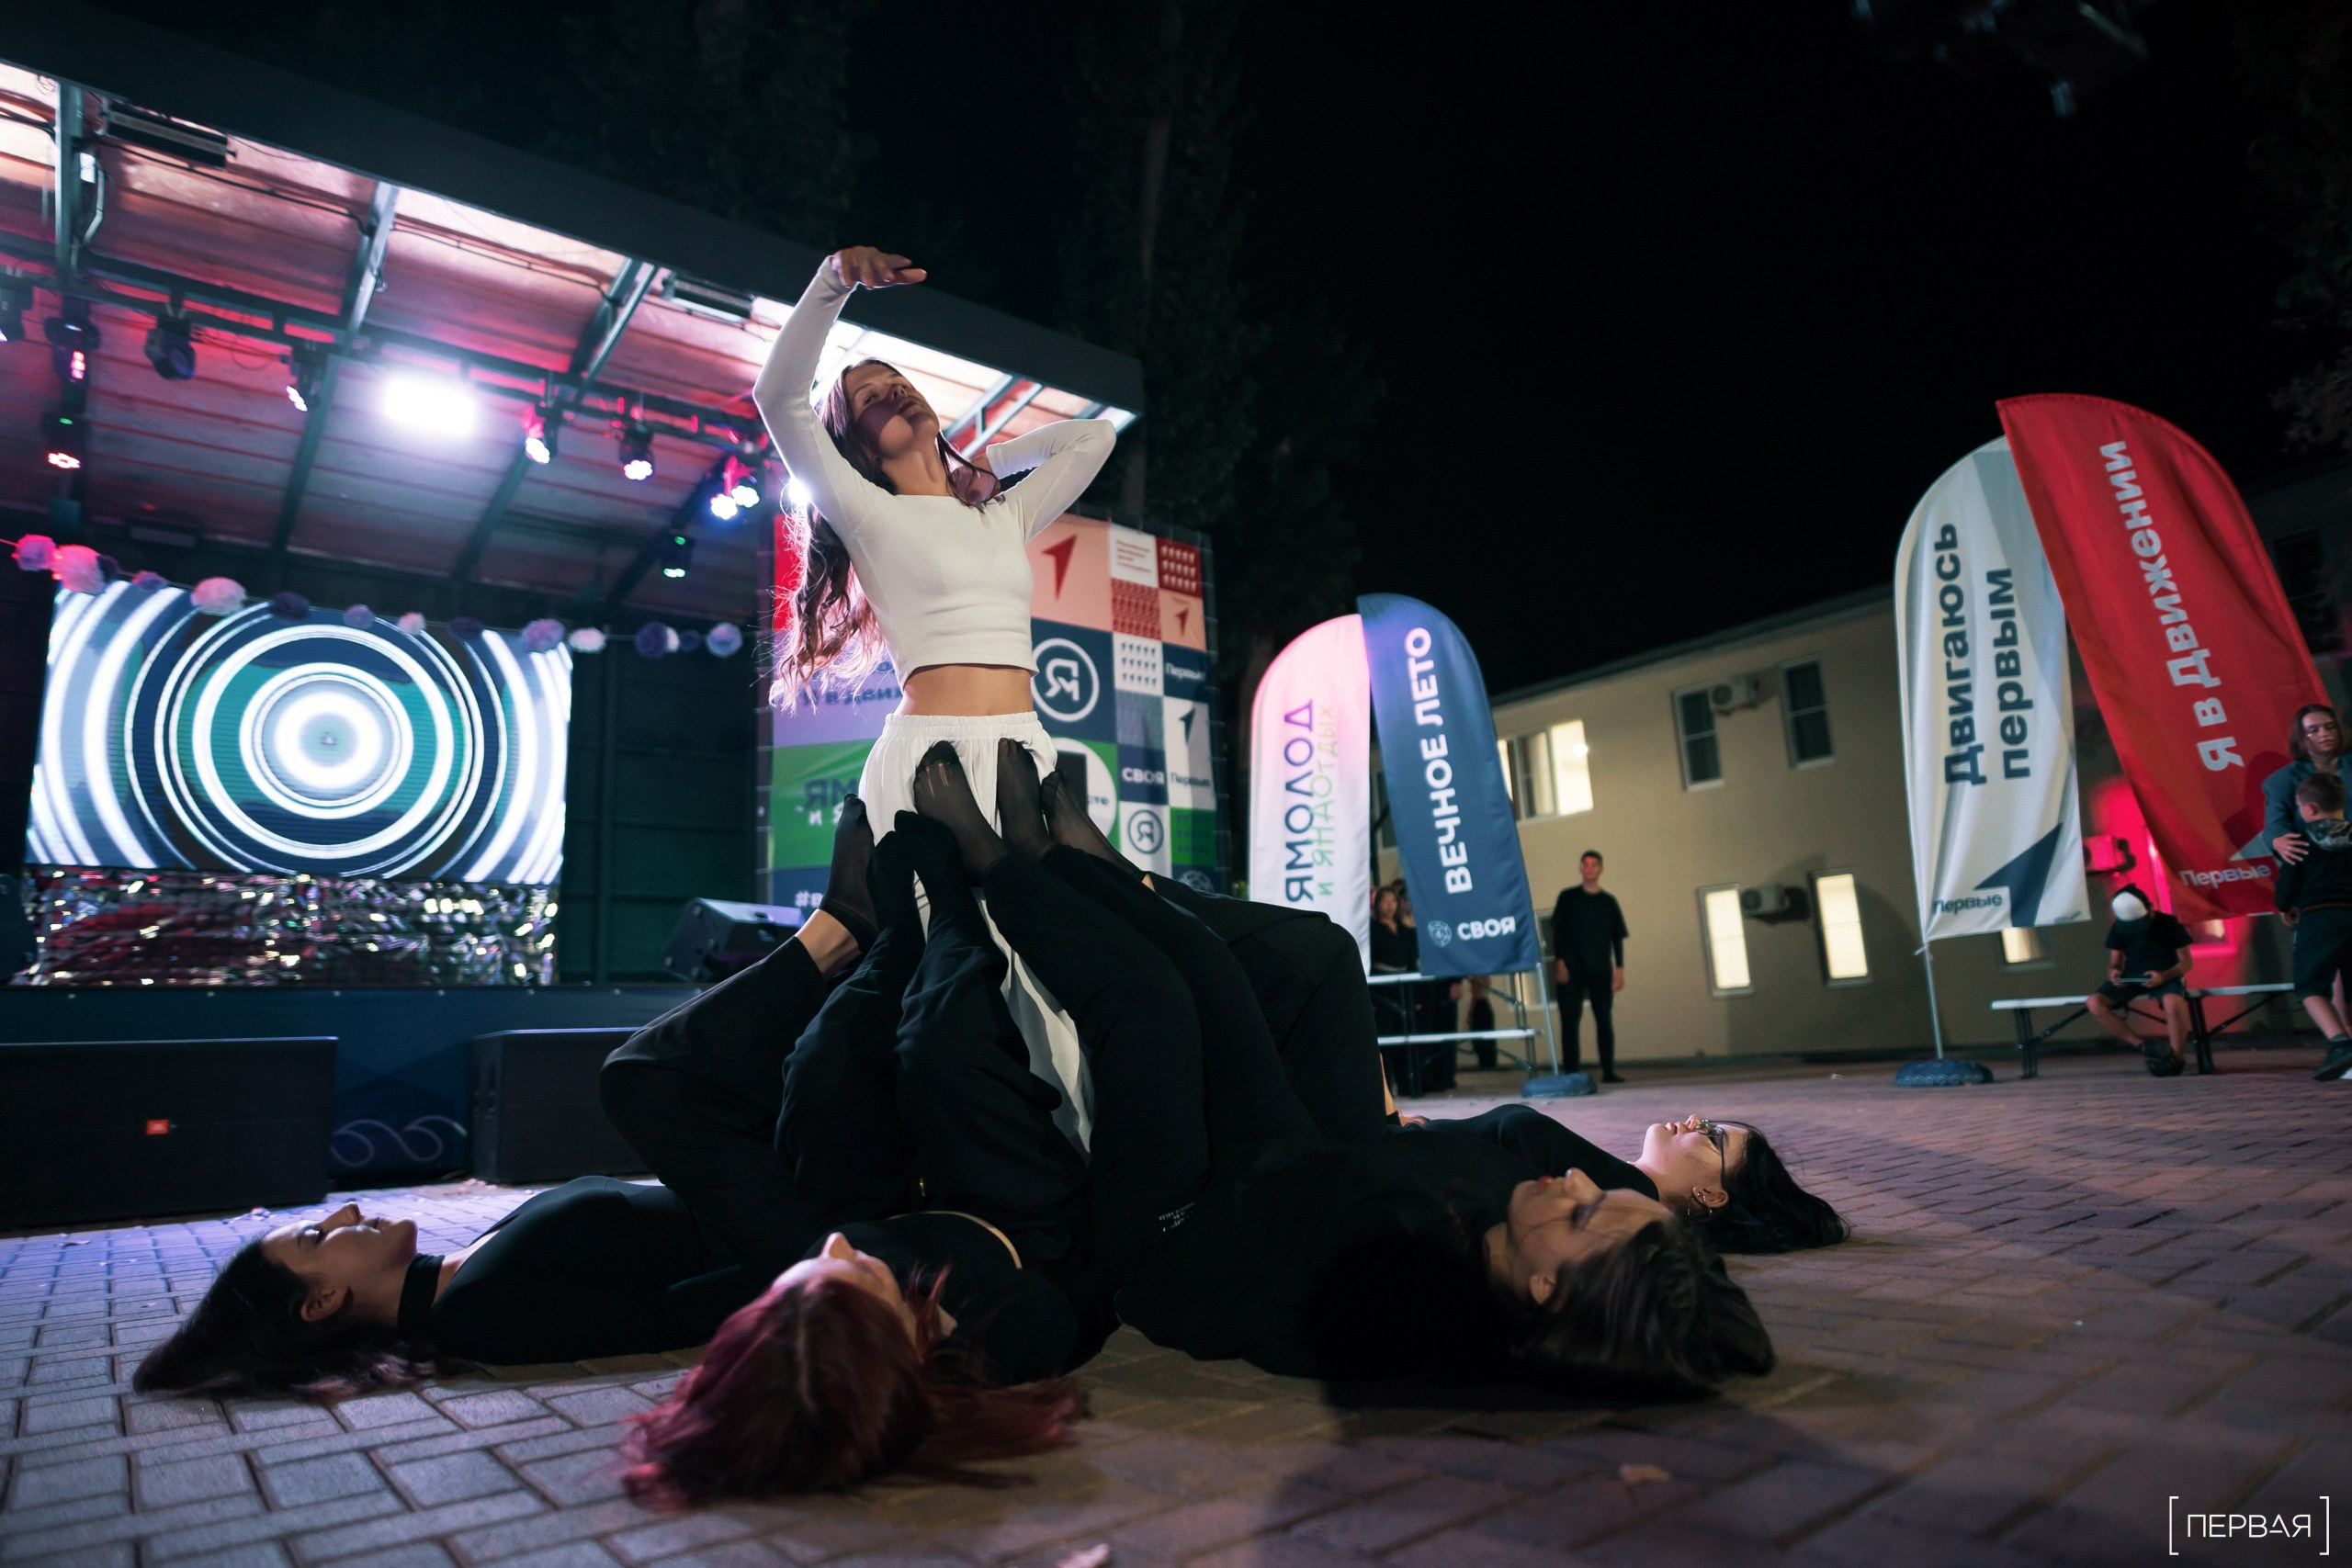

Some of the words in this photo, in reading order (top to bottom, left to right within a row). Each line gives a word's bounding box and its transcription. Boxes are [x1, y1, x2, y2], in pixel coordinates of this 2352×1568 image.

[2099, 441, 2222, 688] Движении
[1405, 627, 1443, 727] ЛЕТО
[1934, 523, 1987, 785] Двигаюсь
[1986, 568, 2034, 780] первым
[2193, 697, 2228, 728] в
[1284, 699, 1314, 902] ЯМОЛОД
[1420, 734, 1474, 894] ВЕЧНОЕ
[2197, 737, 2245, 772] Я
[1457, 916, 1516, 941] СВОЯ
[2179, 864, 2272, 889] Первые
